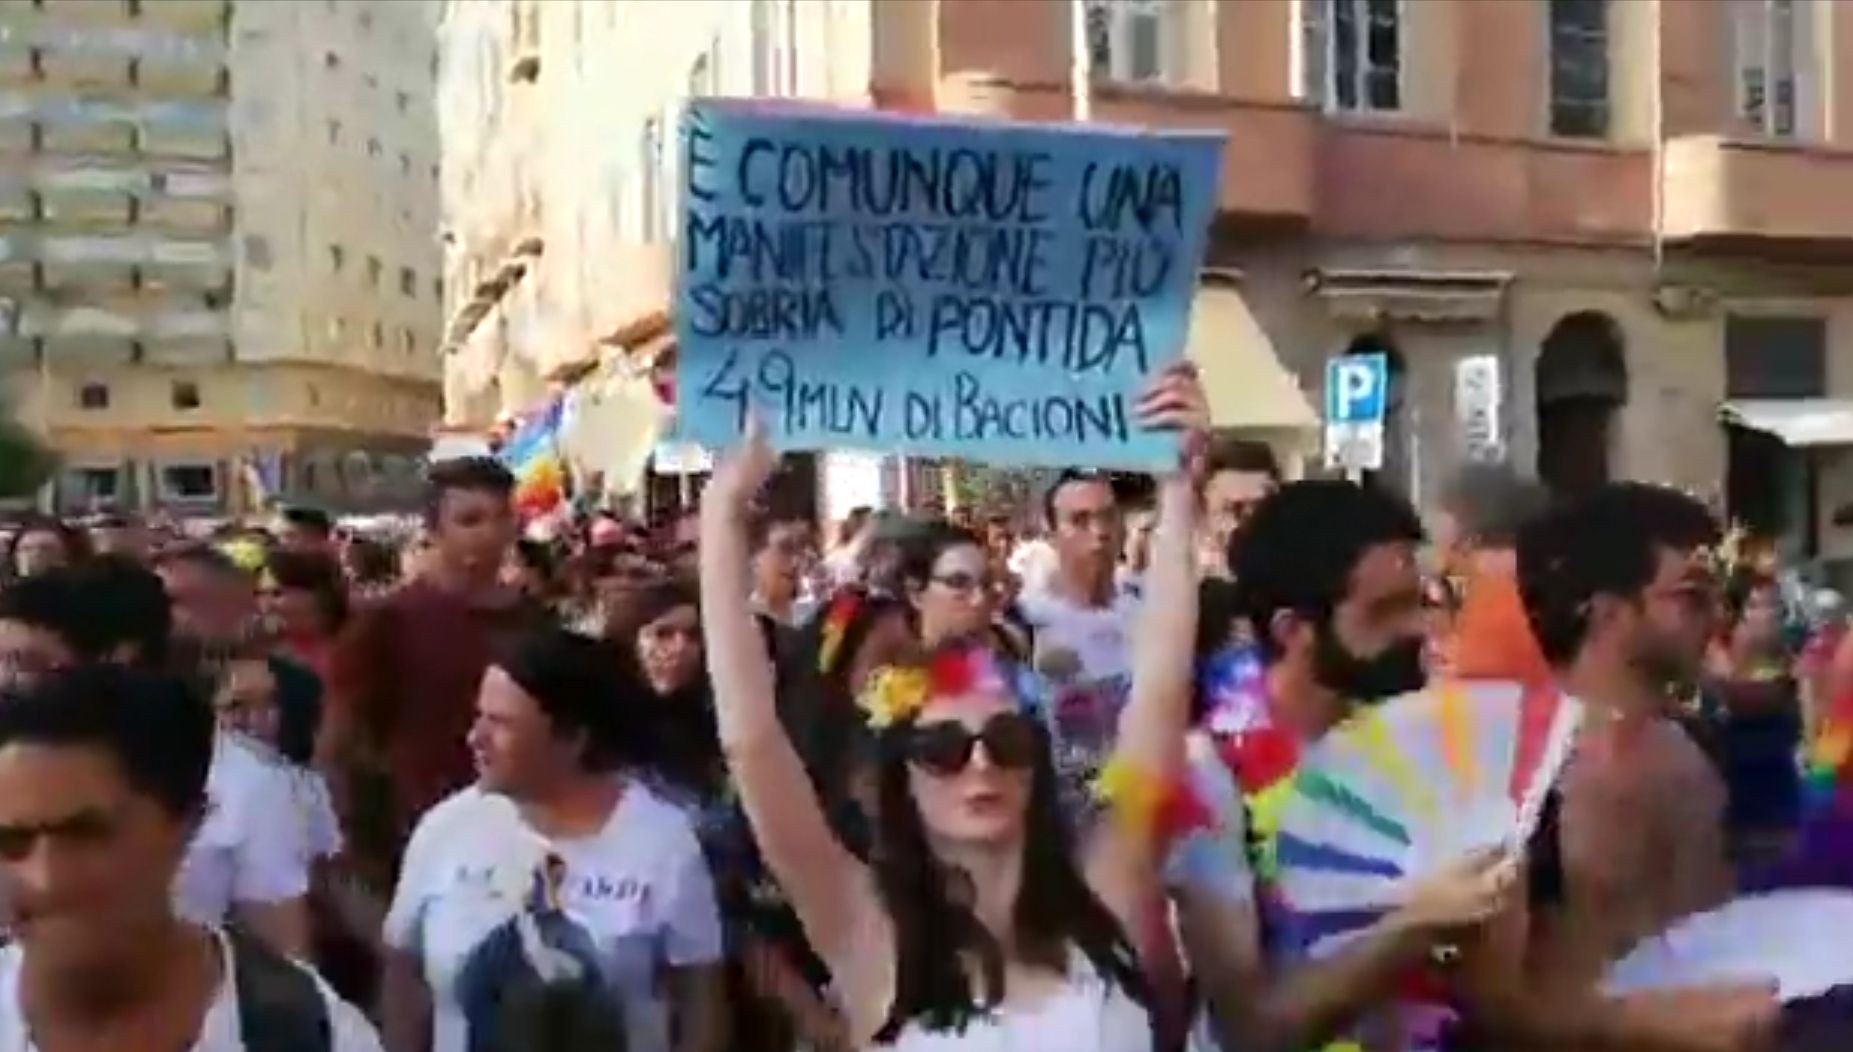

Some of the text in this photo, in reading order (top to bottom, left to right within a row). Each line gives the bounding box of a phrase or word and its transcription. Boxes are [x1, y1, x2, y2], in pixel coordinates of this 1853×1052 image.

[739, 138, 1051, 223] COMUNQUE
[1078, 162, 1184, 240] UNA
[689, 285, 845, 340] SOBRIA
[927, 294, 1147, 374] PONTIDA
[905, 392, 943, 443] DI
[1338, 362, 1374, 419] P
